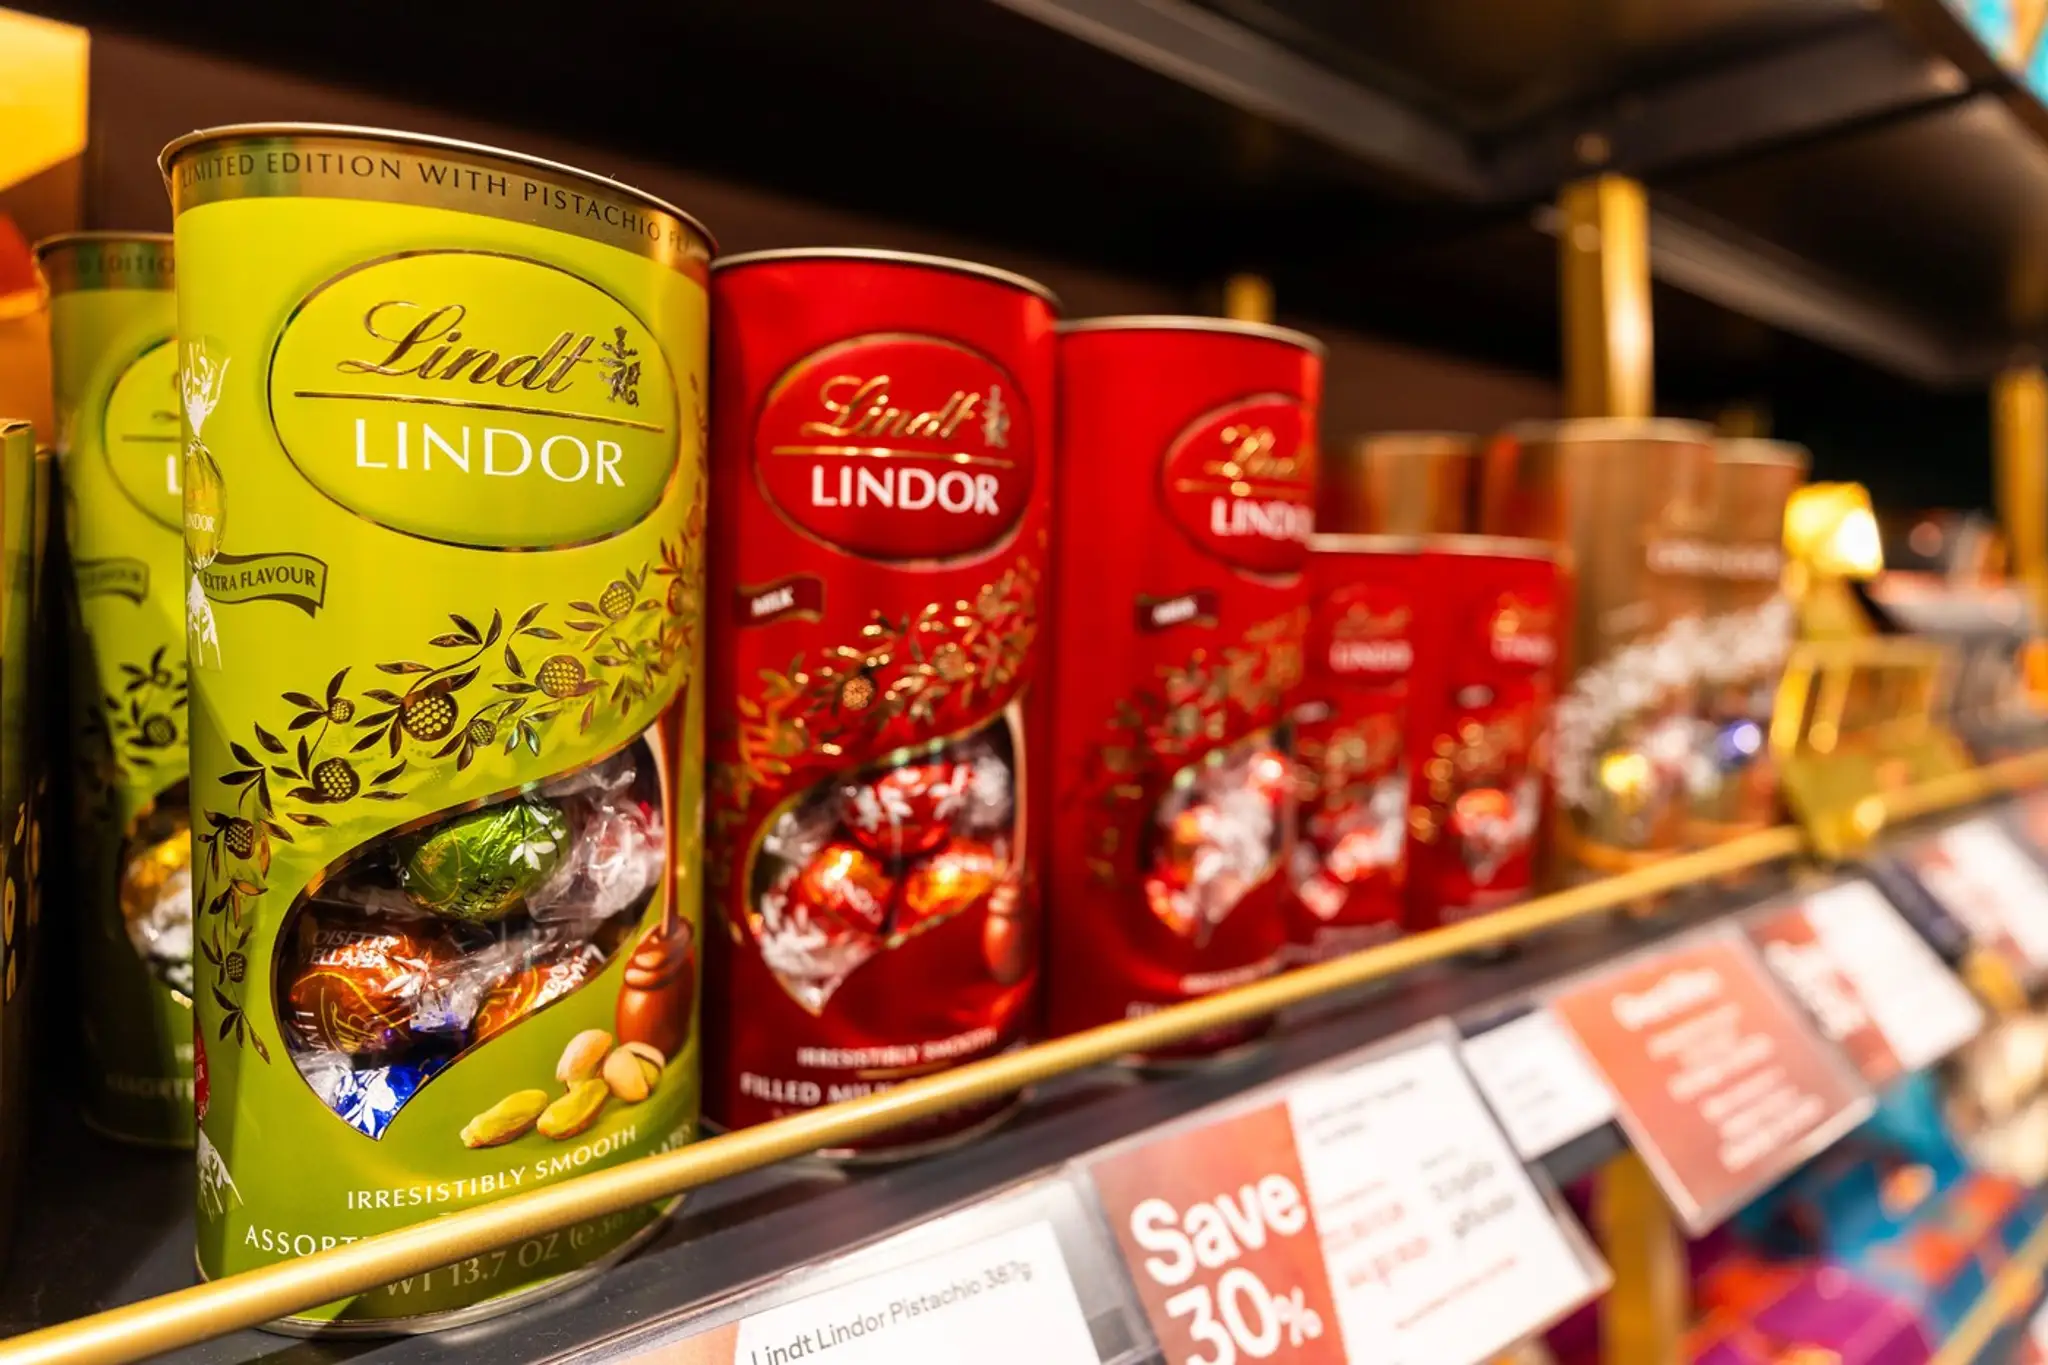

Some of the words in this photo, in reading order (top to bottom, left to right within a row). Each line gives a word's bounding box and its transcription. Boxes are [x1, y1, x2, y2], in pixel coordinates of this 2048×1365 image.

[182, 154, 254, 188] LIMITED
[267, 152, 401, 180] EDITION
[418, 162, 507, 197] WITH
[524, 181, 661, 242] PISTACHIO
[336, 300, 596, 394] Lindt
[801, 374, 981, 439] Lindt
[354, 417, 627, 488] LINDOR
[811, 464, 1000, 516] LINDOR
[203, 571, 238, 592] EXTRA
[240, 565, 317, 588] FLAVOUR
[739, 1071, 822, 1106] FILLED
[347, 1166, 526, 1210] IRRESISTIBLY
[534, 1124, 637, 1180] SMOOTH
[448, 1250, 507, 1288] 13.7
[517, 1232, 561, 1268] OZ
[1130, 1173, 1308, 1287] Save
[816, 1311, 886, 1351] Lindor
[888, 1276, 983, 1326] Pistachio
[1164, 1267, 1323, 1365] 30%
